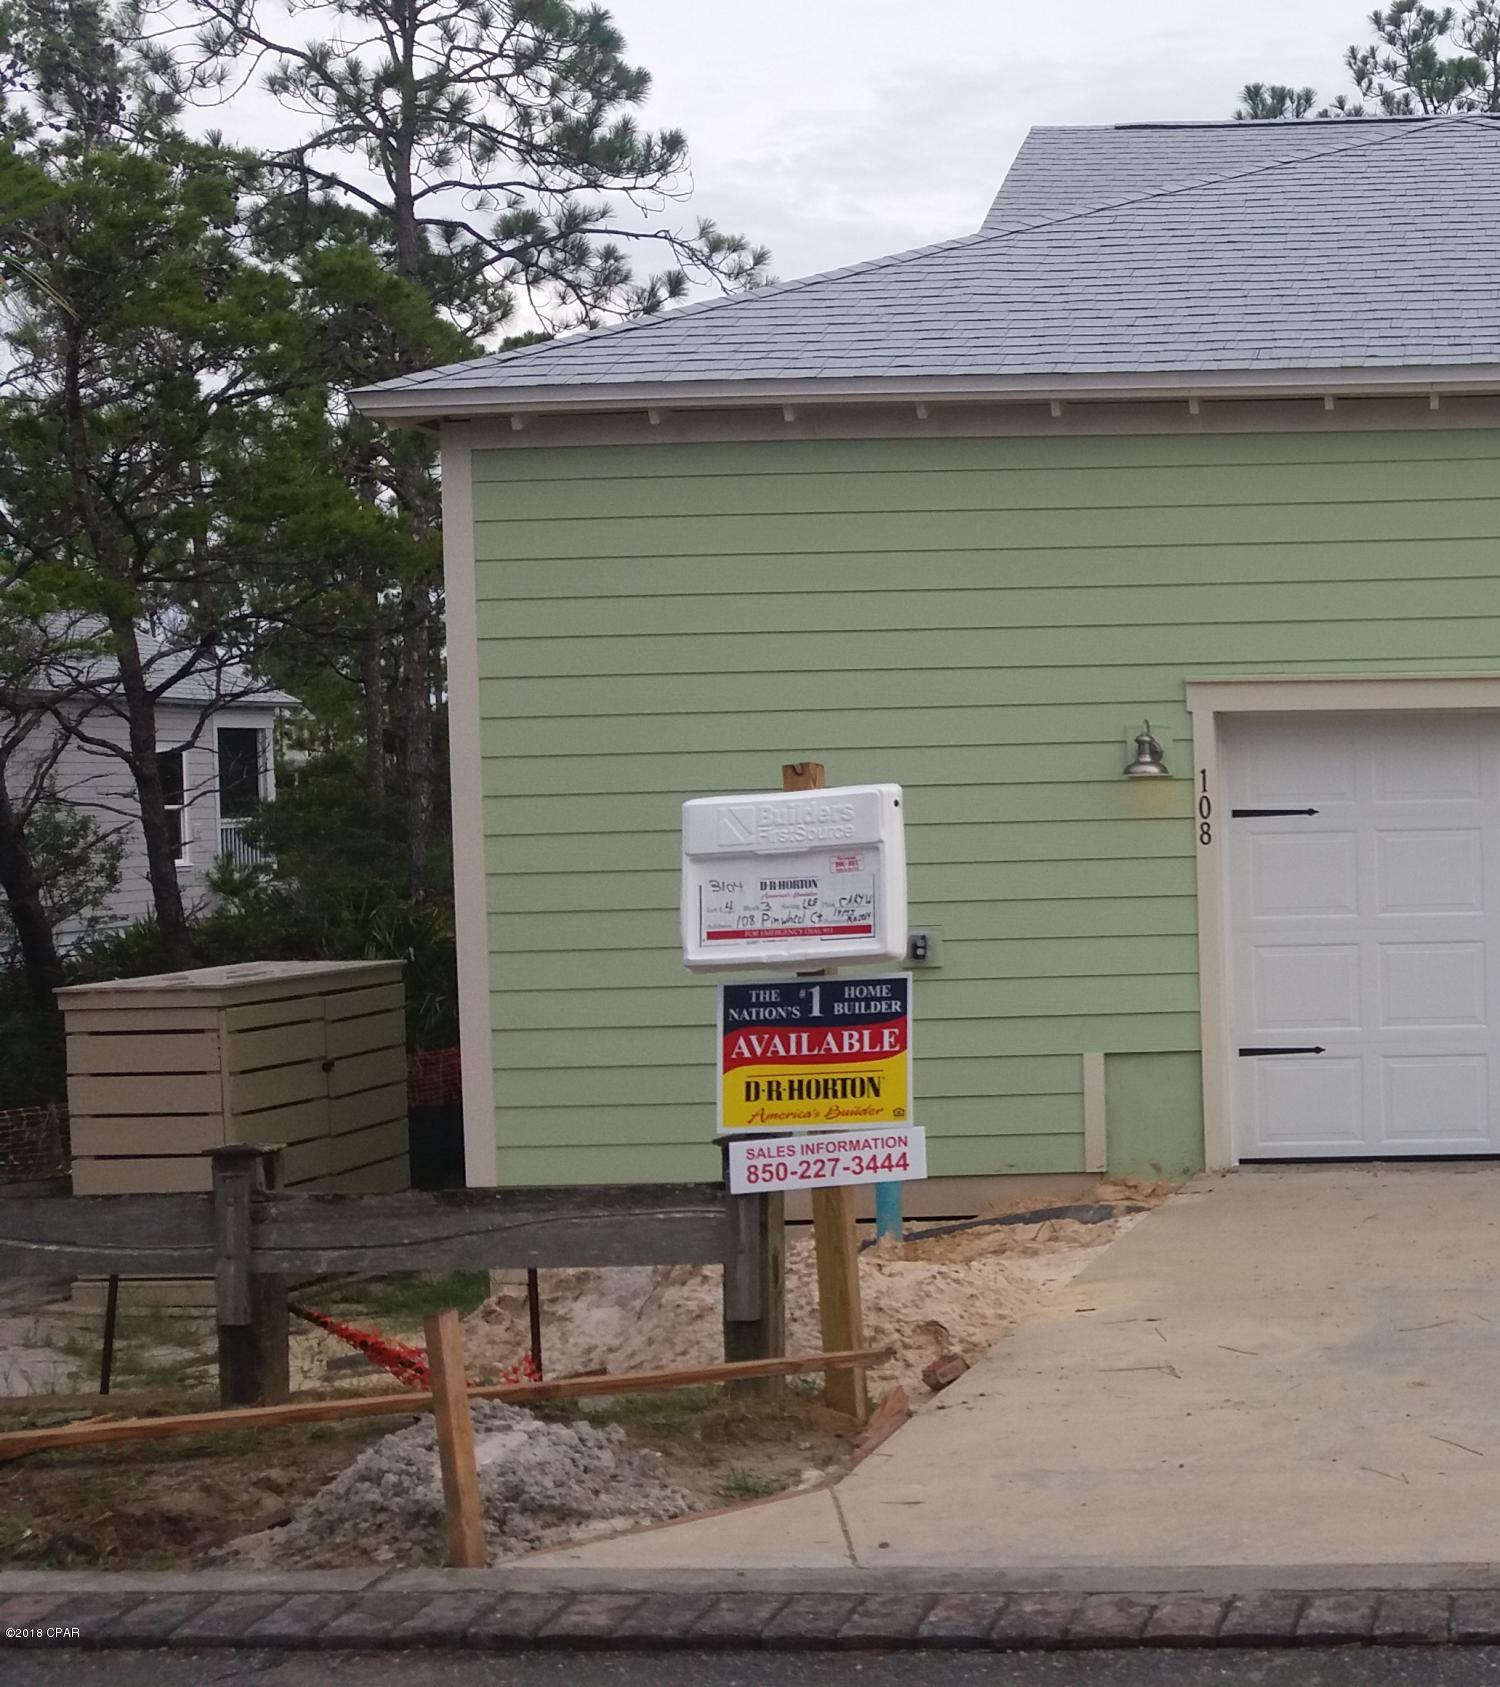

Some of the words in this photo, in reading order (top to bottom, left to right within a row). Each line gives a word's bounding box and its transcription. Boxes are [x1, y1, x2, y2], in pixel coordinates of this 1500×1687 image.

[758, 802, 855, 825] Builders
[1199, 768, 1211, 845] 108
[758, 824, 854, 844] FirstSource
[760, 901, 772, 911] 3
[736, 914, 755, 928] 108
[749, 990, 780, 1002] THE
[844, 985, 891, 998] HOME
[729, 1007, 800, 1021] NATION'S
[834, 1001, 901, 1015] BUILDER
[730, 1028, 899, 1058] AVAILABLE
[747, 1107, 820, 1124] America's
[824, 1105, 884, 1120] Builder
[746, 1145, 796, 1160] SALES
[800, 1136, 908, 1155] INFORMATION
[746, 1152, 909, 1184] 850-227-3444
